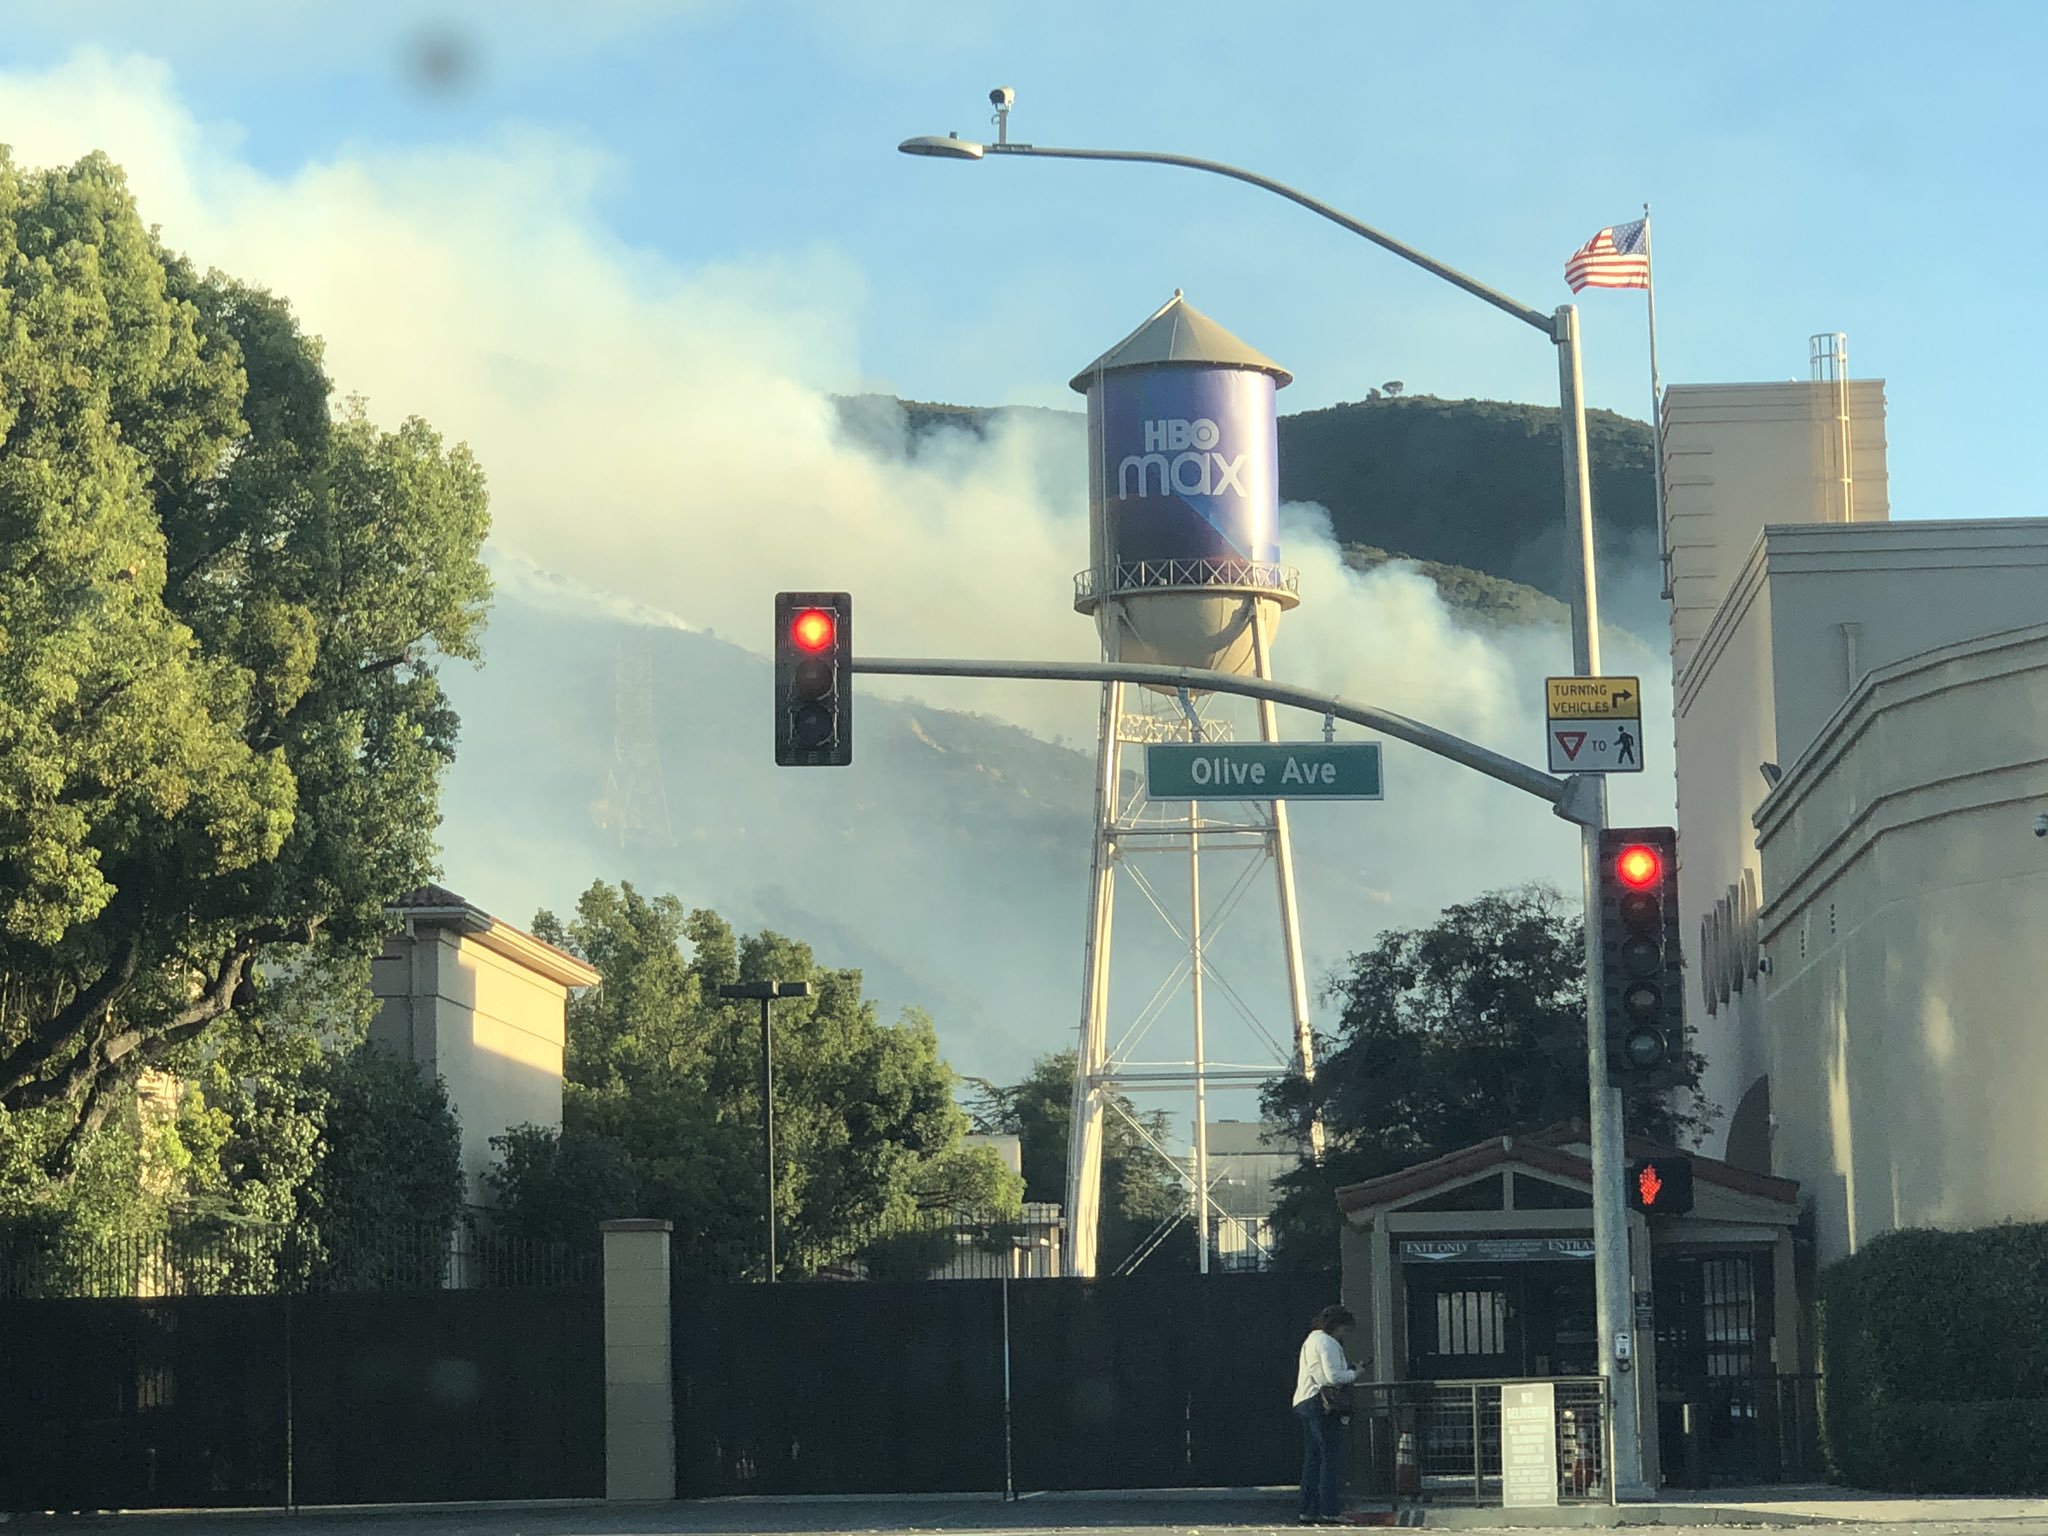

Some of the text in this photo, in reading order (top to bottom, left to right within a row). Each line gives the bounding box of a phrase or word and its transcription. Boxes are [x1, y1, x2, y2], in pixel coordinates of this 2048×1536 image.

[1145, 418, 1220, 452] HBO
[1118, 451, 1248, 500] max
[1553, 684, 1607, 697] TURNING
[1552, 701, 1610, 714] VEHICLES
[1592, 740, 1607, 752] TO
[1191, 756, 1337, 785] Olive Ave
[1407, 1243, 1434, 1254] EXIT
[1437, 1242, 1469, 1253] ONLY
